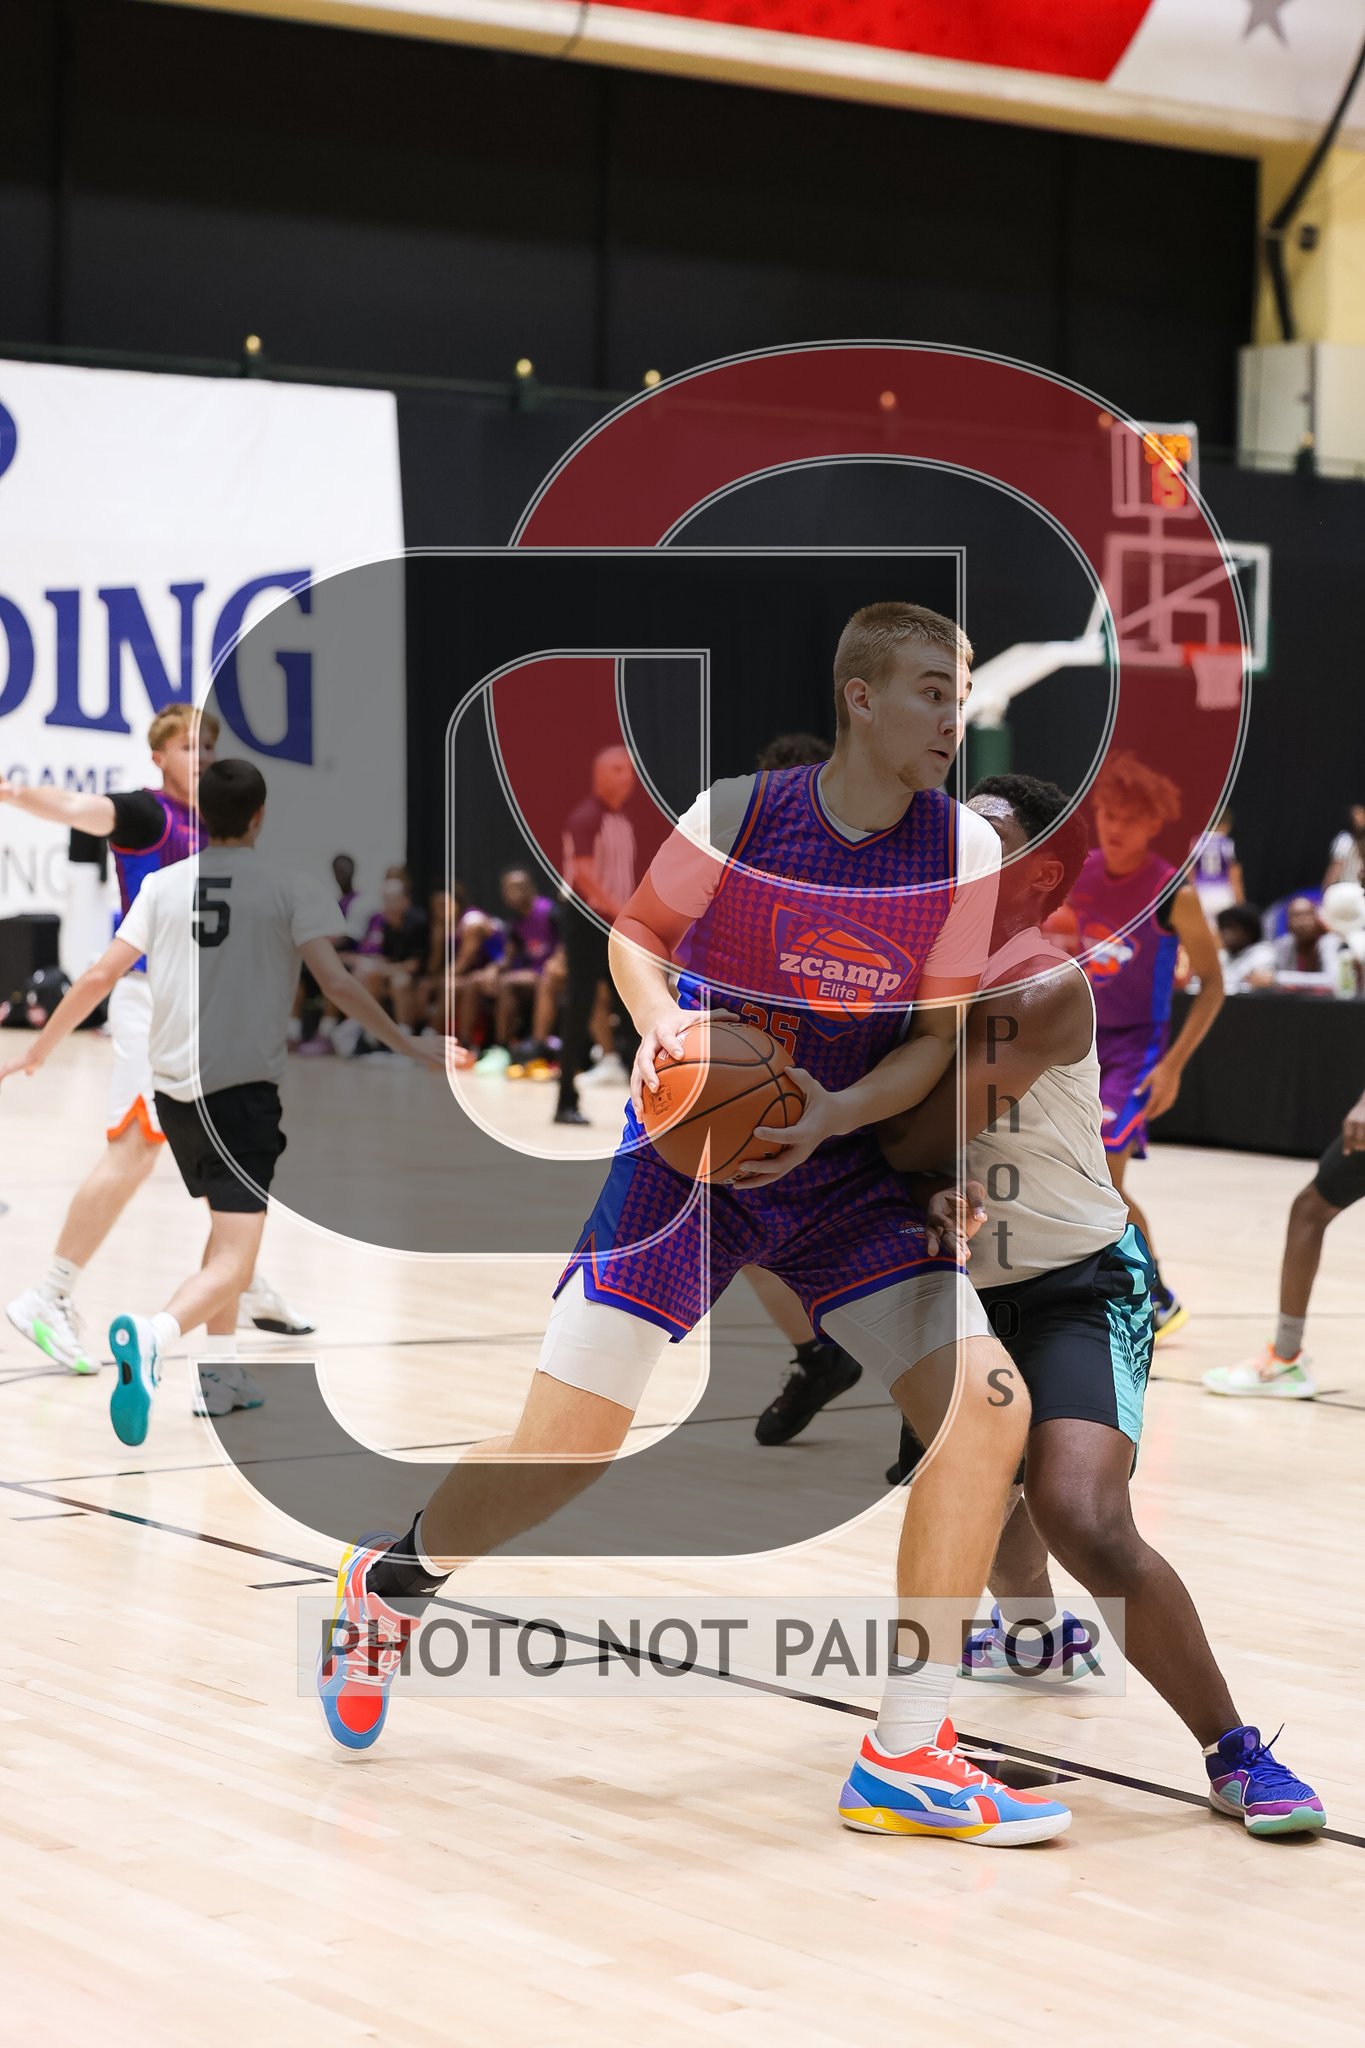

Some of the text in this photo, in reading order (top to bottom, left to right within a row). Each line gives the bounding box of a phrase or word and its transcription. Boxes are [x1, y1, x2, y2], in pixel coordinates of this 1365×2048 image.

[192, 877, 232, 948] 5
[779, 952, 902, 997] zcamp
[818, 981, 857, 1001] Elite
